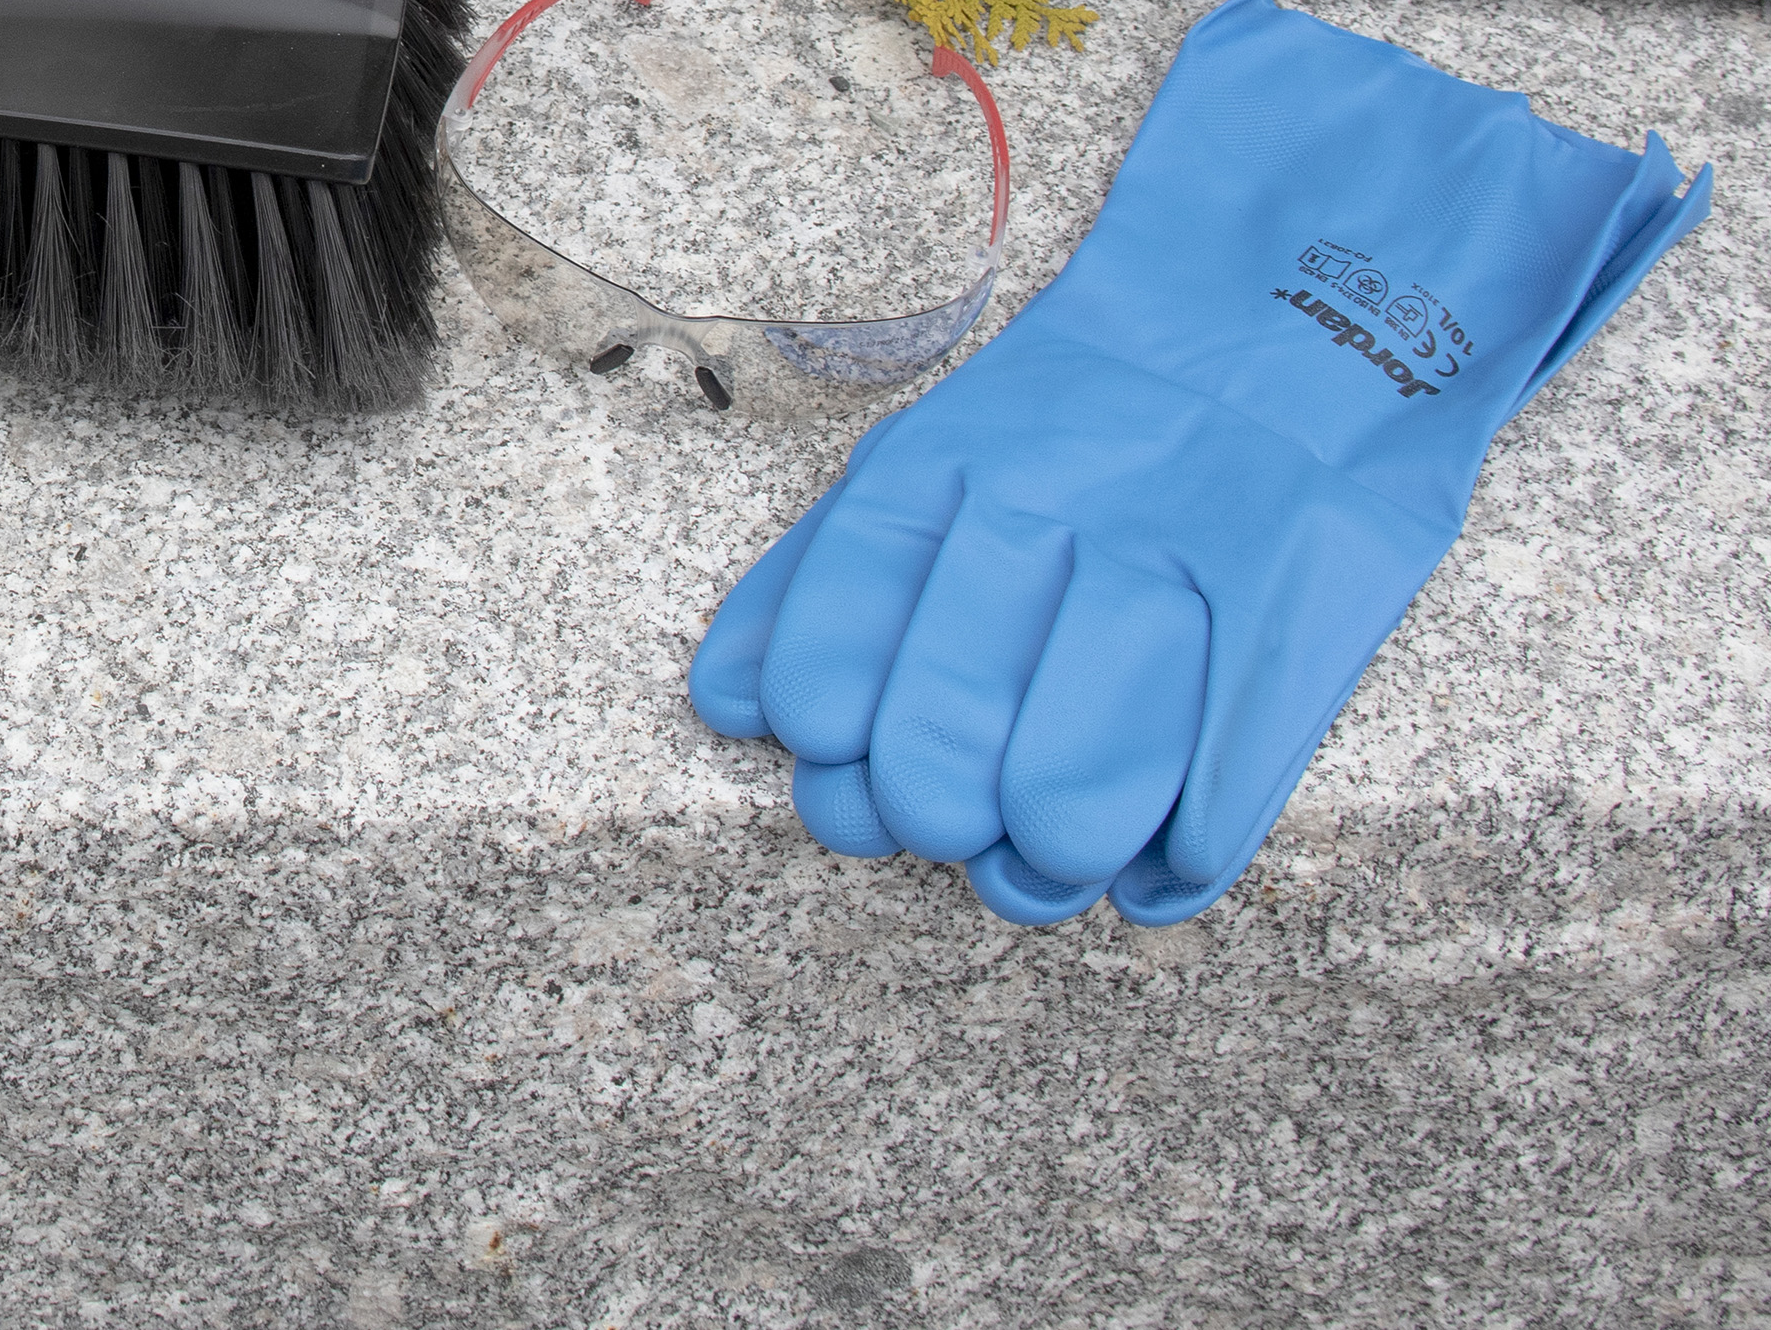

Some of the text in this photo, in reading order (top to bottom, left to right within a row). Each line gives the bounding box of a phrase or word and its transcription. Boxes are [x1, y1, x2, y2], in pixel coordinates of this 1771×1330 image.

[1298, 266, 1328, 283] EN 420
[1353, 297, 1368, 308] ISO
[1411, 282, 1439, 306] 3101X
[1368, 305, 1381, 317] EN
[1398, 329, 1410, 341] EN
[1439, 306, 1474, 356] 10/L
[1289, 289, 1440, 398] Jordan
